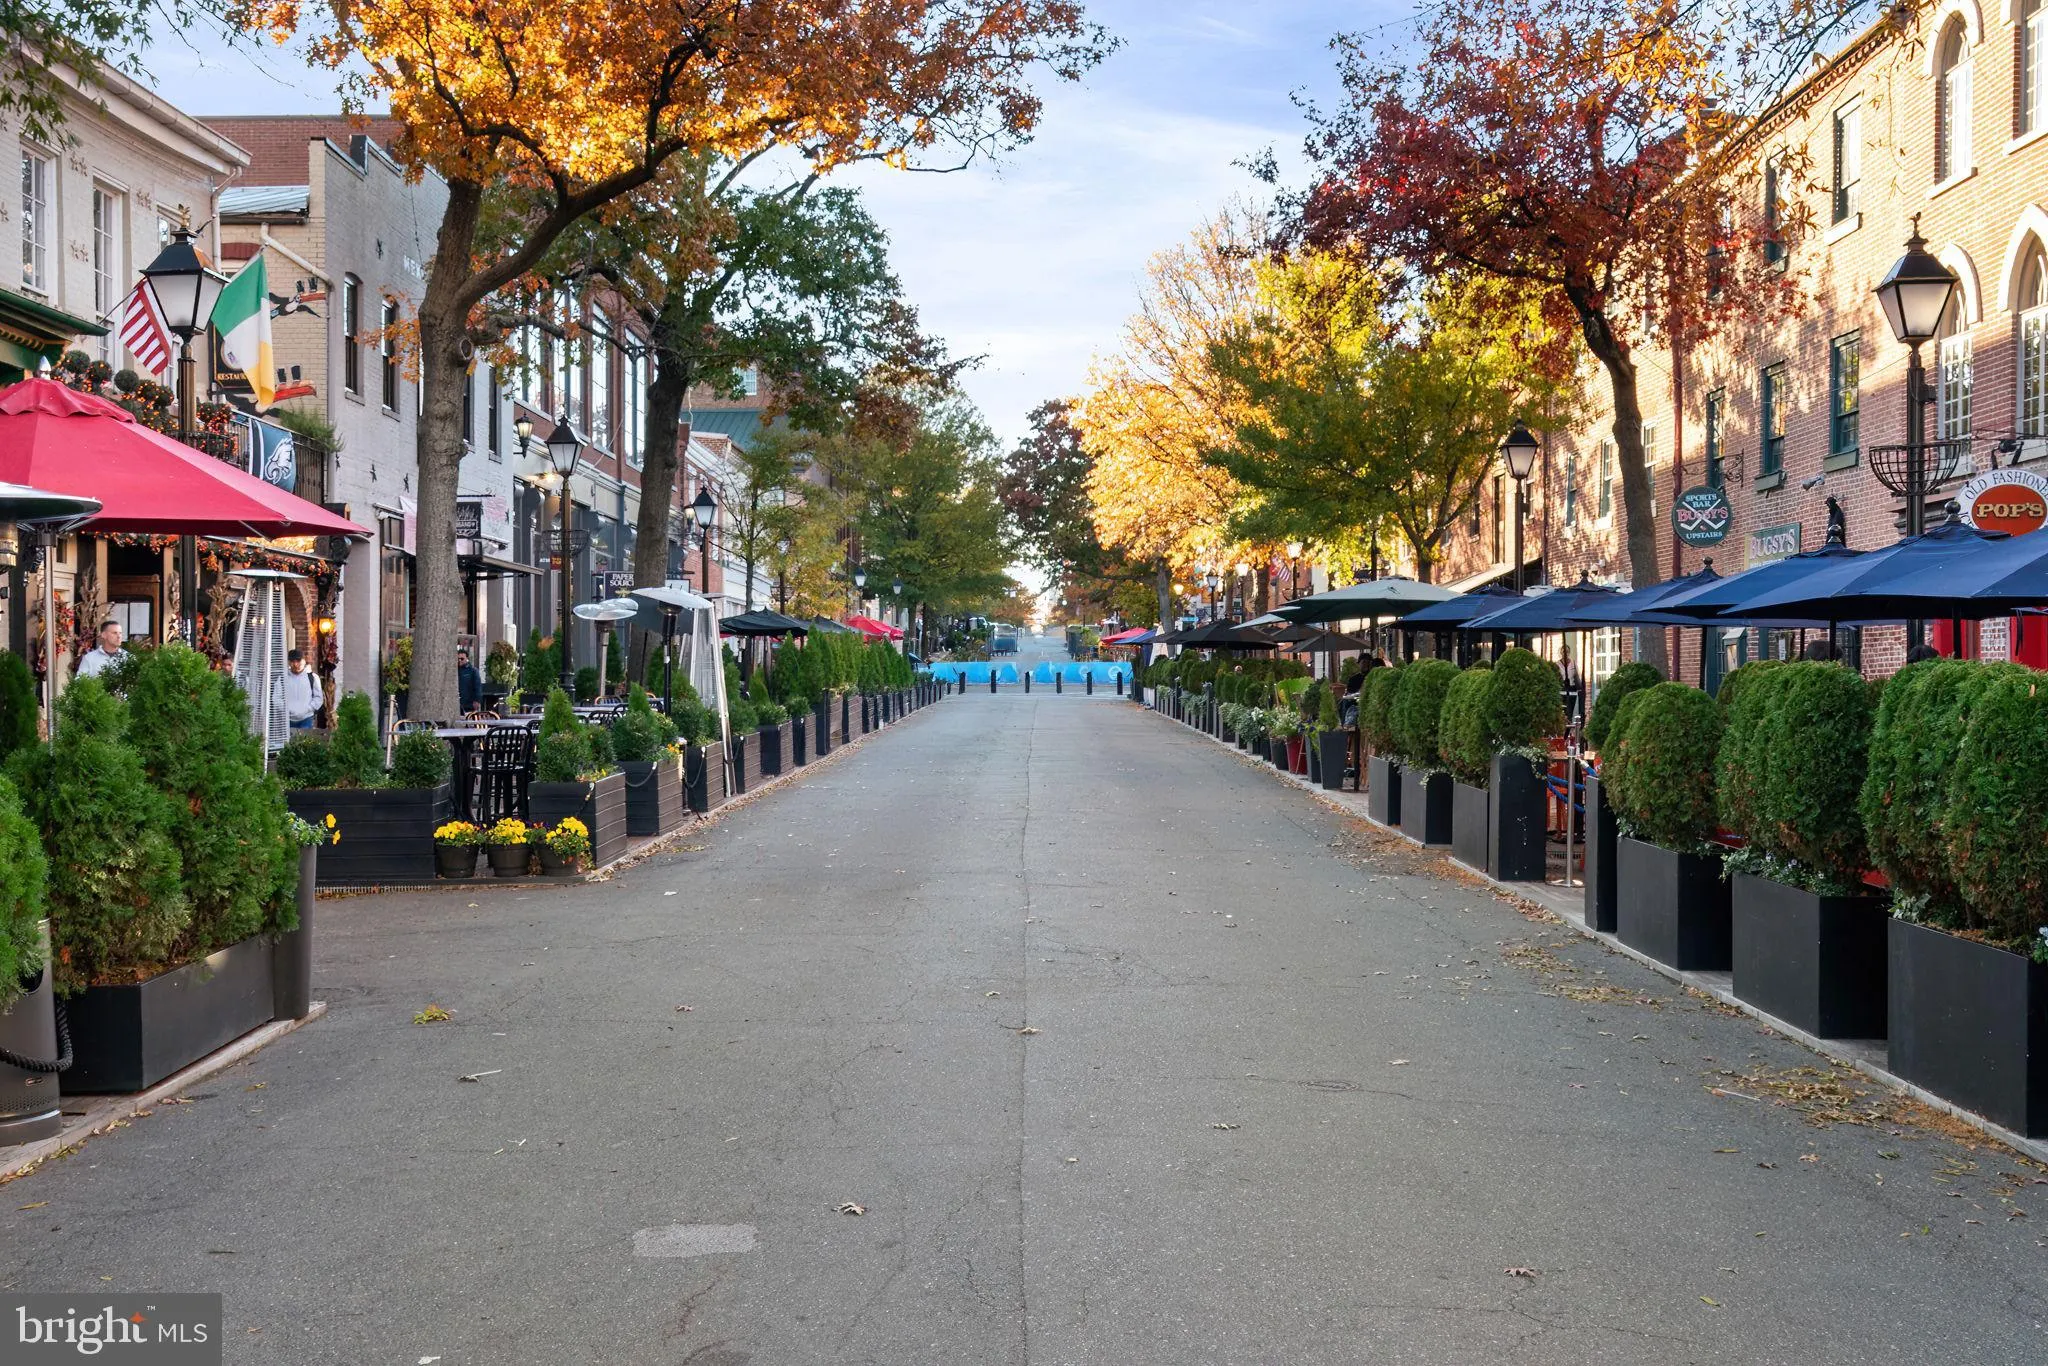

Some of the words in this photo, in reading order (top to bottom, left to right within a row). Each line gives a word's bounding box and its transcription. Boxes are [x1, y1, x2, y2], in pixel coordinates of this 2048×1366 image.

[1965, 478, 1988, 500] OLD
[1992, 471, 2048, 499] FASHIONE
[1685, 493, 1717, 501] SPORTS
[1692, 500, 1711, 508] BAR
[1977, 502, 2044, 518] POP'S
[1686, 531, 1723, 540] UPSTAIRS
[1750, 528, 1795, 560] BUGSY'S
